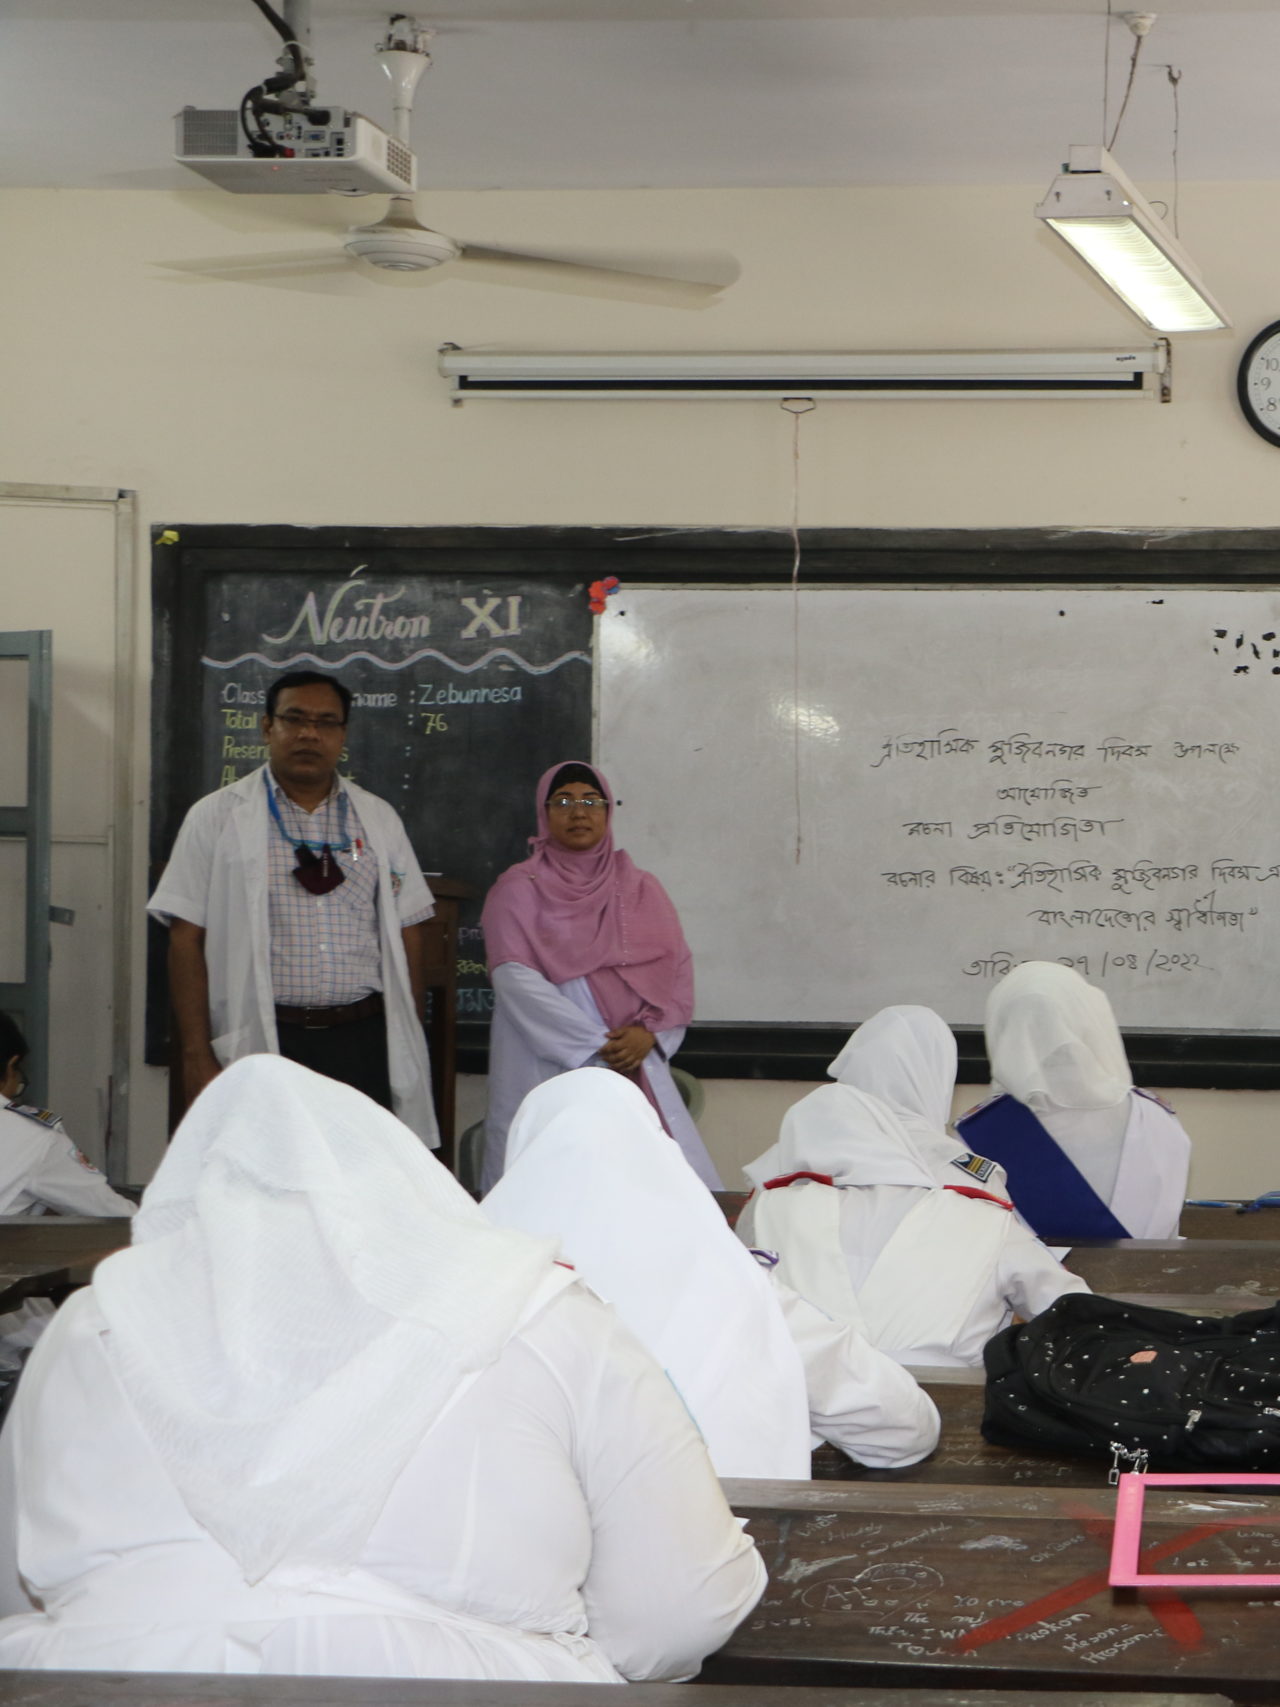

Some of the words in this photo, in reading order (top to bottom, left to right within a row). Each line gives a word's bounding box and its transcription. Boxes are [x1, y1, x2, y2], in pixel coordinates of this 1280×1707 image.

[1265, 358, 1279, 371] 10
[1261, 377, 1271, 390] 9
[1266, 397, 1277, 412] 8
[262, 565, 430, 645] Neutron
[460, 596, 522, 639] XI
[418, 684, 523, 705] Zebunnesa
[220, 708, 258, 730] Total
[420, 713, 448, 735] 76
